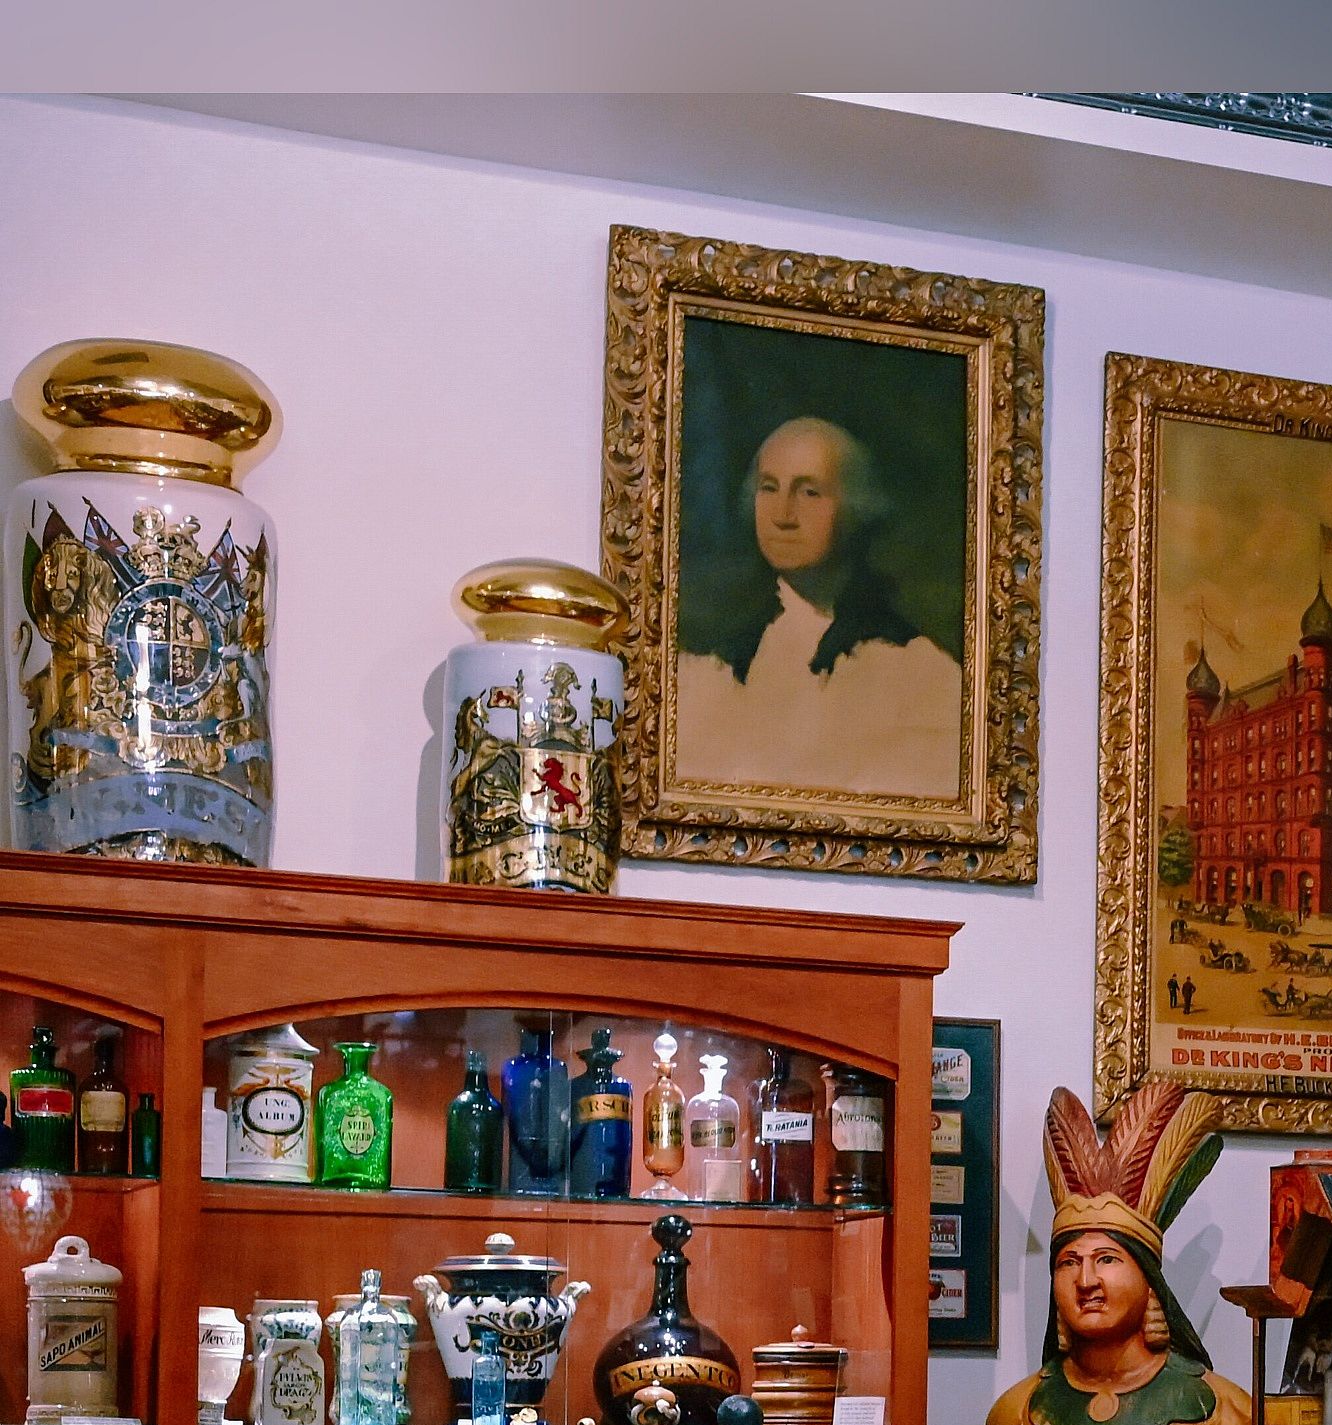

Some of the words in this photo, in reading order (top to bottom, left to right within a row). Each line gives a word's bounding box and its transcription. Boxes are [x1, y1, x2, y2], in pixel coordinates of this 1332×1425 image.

[1210, 1050, 1303, 1071] KING'S
[258, 1111, 296, 1122] ALBUM
[40, 1343, 66, 1369] SAPO
[66, 1322, 104, 1350] ANIMAL
